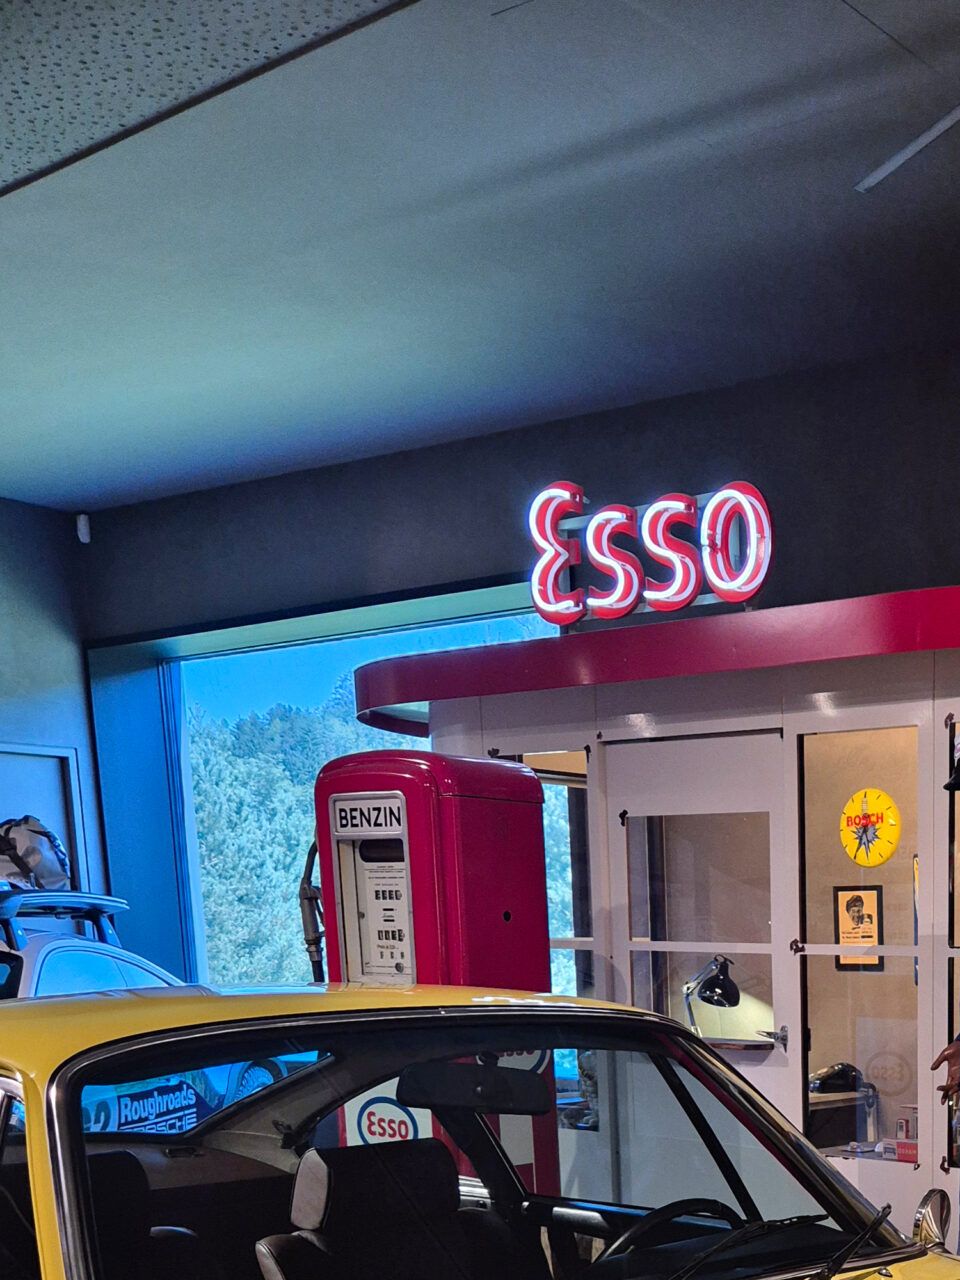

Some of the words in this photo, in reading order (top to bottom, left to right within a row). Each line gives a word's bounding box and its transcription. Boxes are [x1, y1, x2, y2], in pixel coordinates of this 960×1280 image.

[339, 806, 402, 828] BENZIN
[846, 812, 884, 828] BOSCH
[120, 1083, 197, 1124] Roughroads
